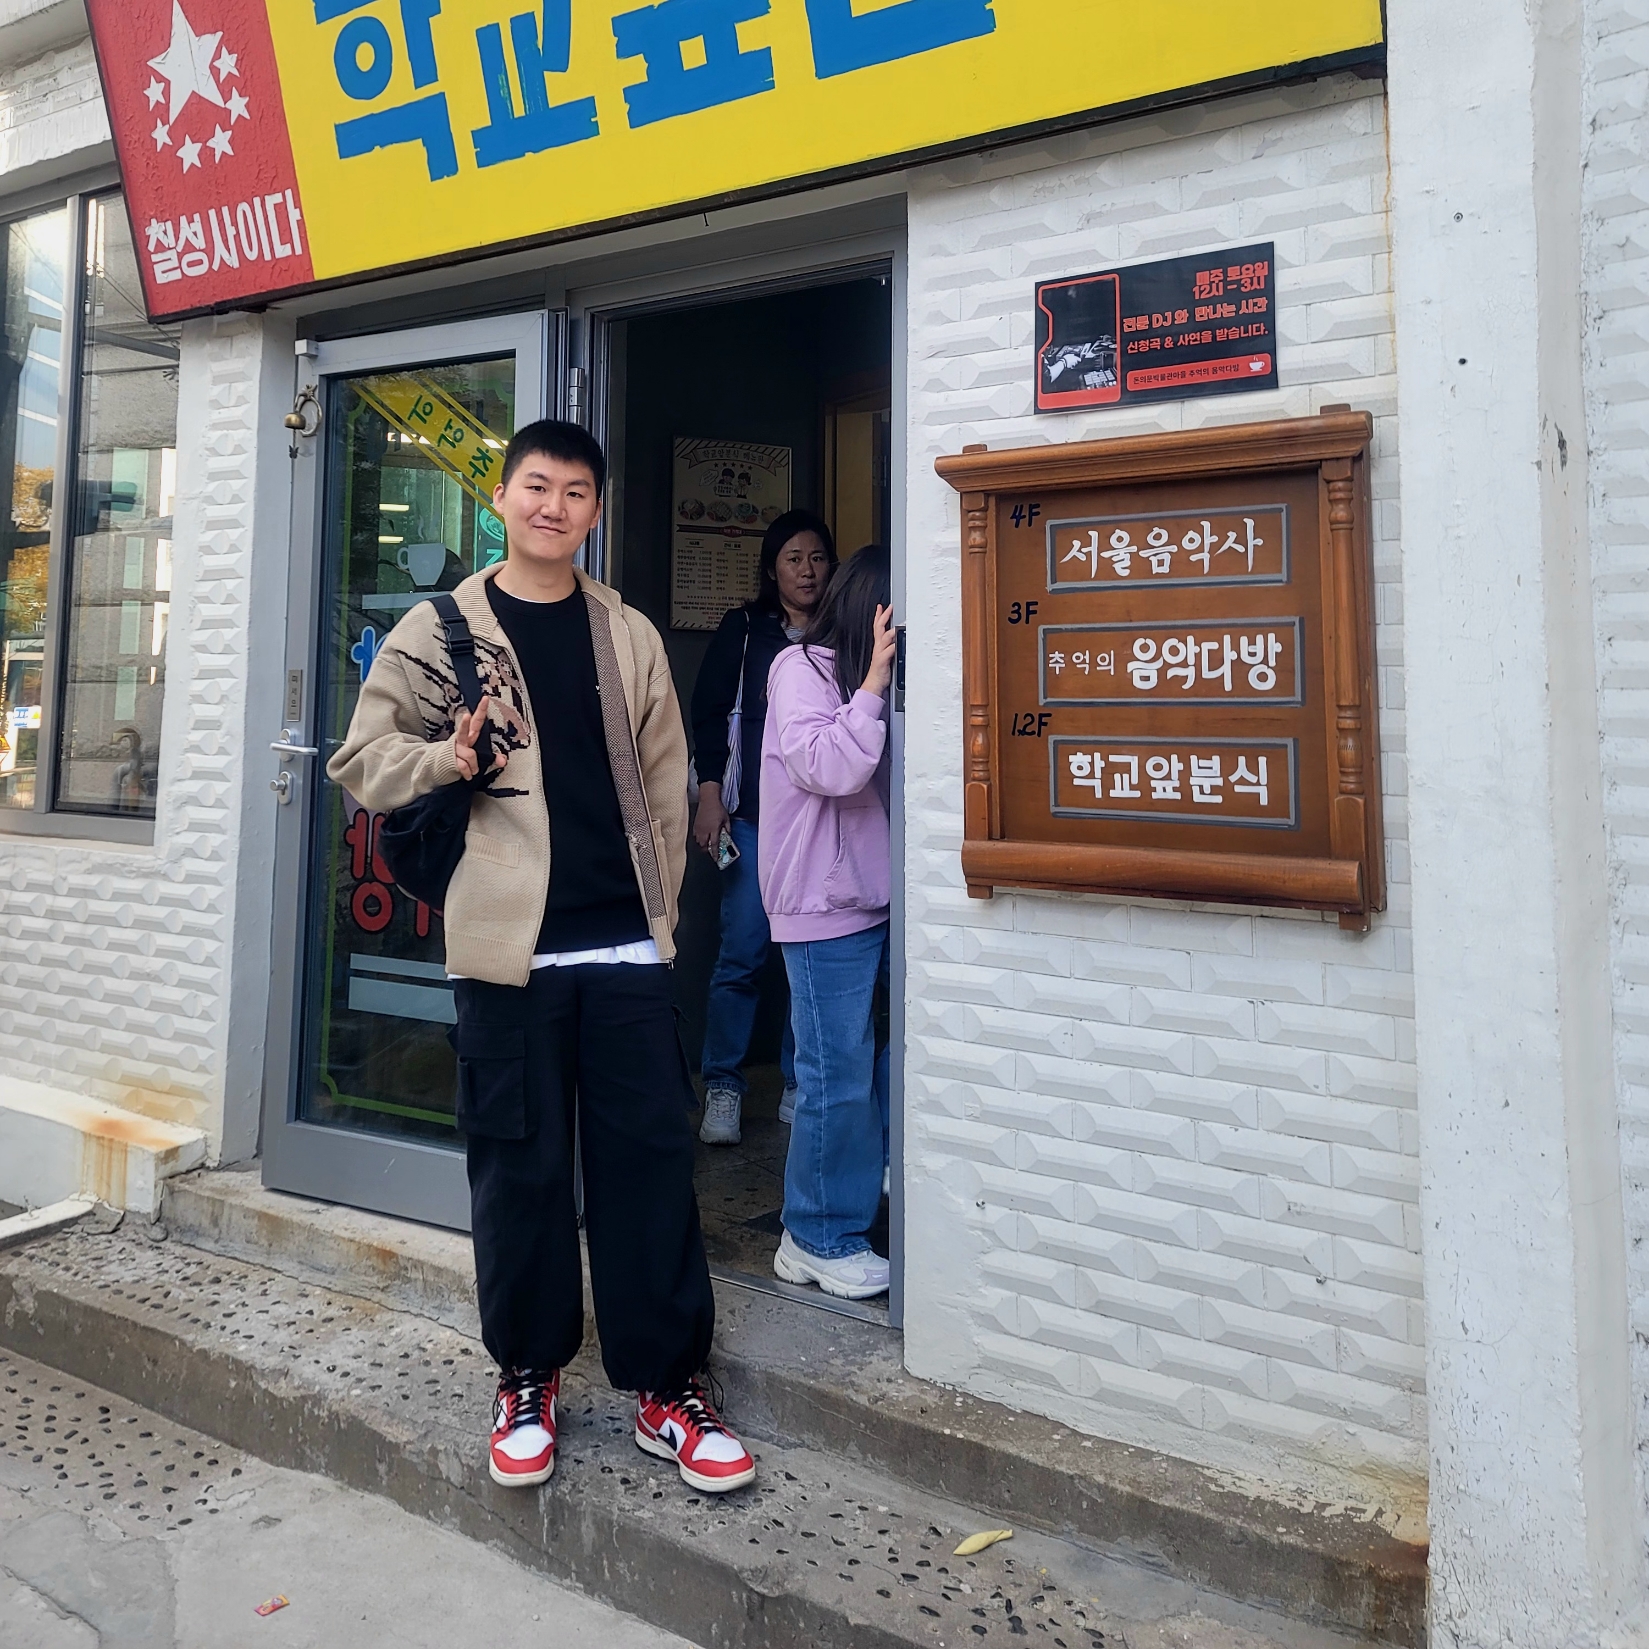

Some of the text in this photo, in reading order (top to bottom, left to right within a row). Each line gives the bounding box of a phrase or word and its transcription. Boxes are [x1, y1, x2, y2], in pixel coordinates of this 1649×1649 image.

[145, 188, 302, 285] 칠성사이다
[1192, 281, 1224, 300] 12시
[1240, 275, 1265, 293] 3시
[1196, 261, 1269, 286] 매주 토요일
[1122, 315, 1150, 333] 전문
[1194, 302, 1236, 322] 만나는
[1239, 296, 1268, 315] 시간
[1127, 322, 1269, 354] 신청곡 & 사연을 받습니다.
[1189, 367, 1210, 377] 추억의
[1211, 363, 1240, 375] 음악다방
[1010, 503, 1041, 529] 4F
[1059, 517, 1264, 579] 서울음악사
[1007, 601, 1039, 625] 3F
[1048, 632, 1283, 692] 추억의 음악다방
[1068, 751, 1269, 806] 학교앞분식
